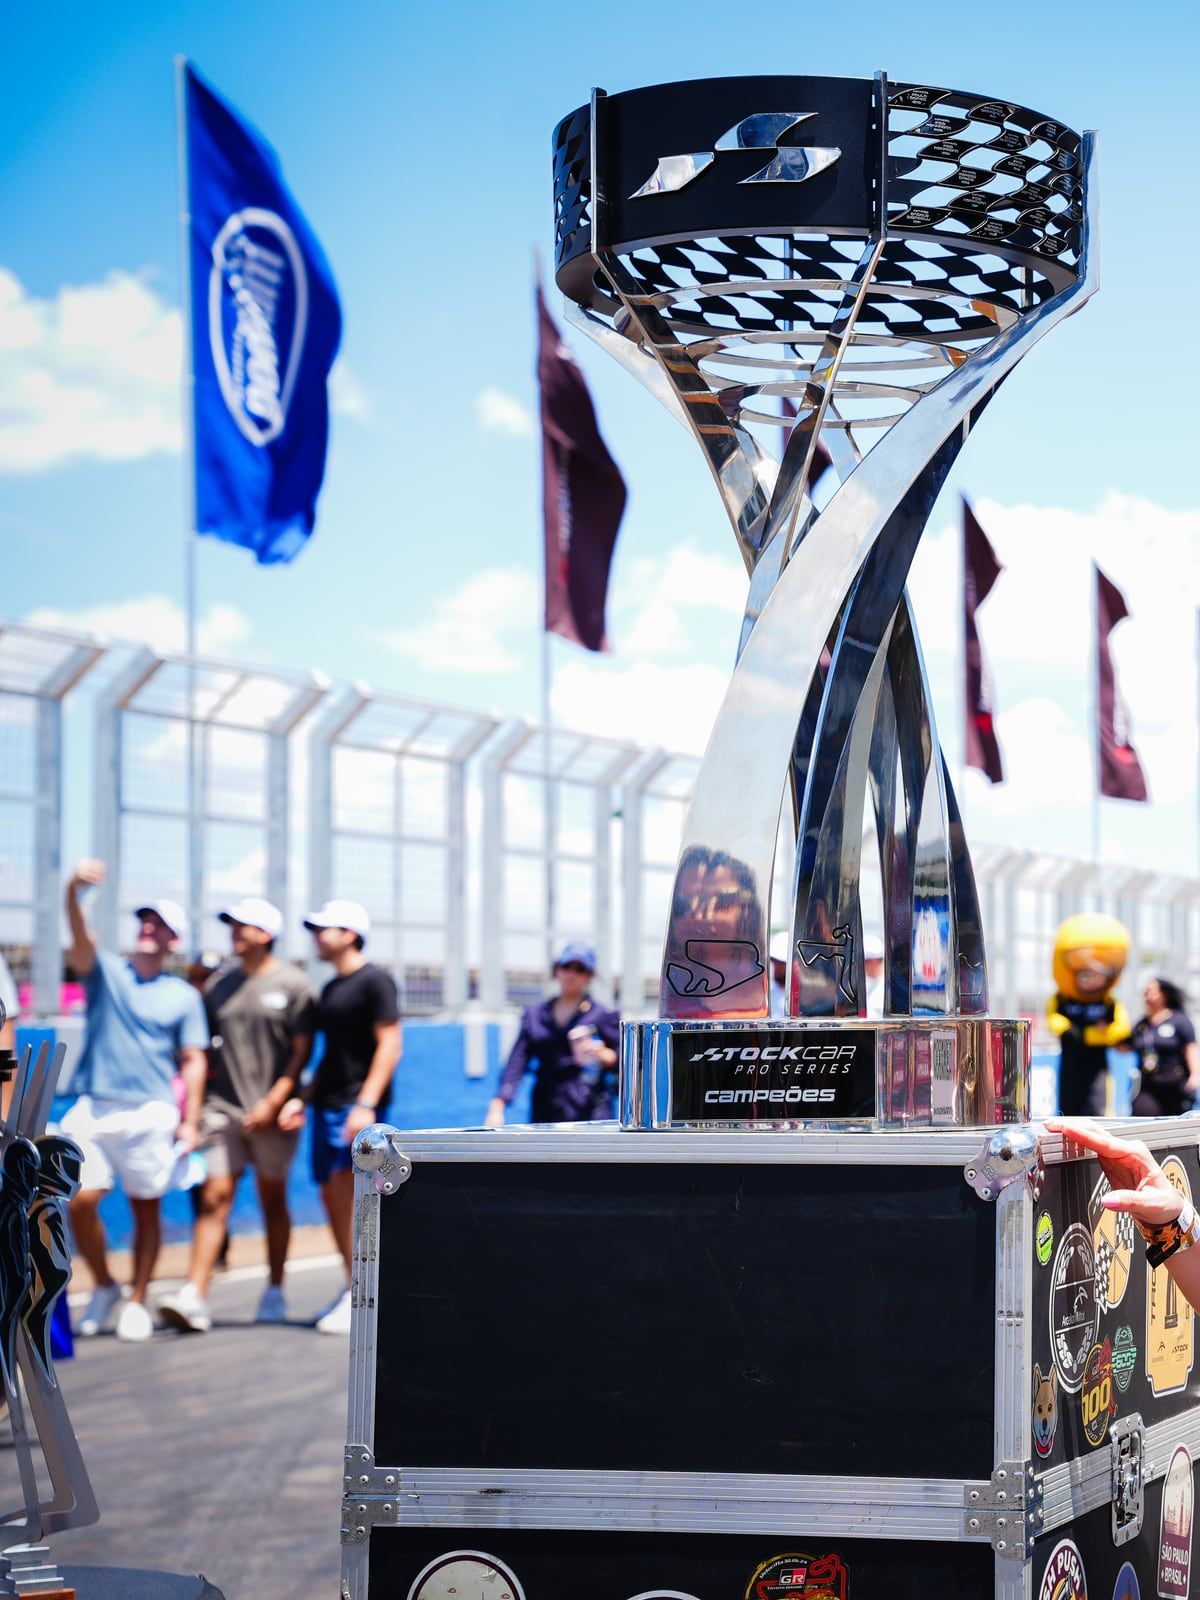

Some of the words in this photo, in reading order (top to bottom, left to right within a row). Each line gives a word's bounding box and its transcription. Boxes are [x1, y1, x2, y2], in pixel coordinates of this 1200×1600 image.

[734, 1064, 770, 1075] PRO
[781, 1063, 852, 1075] SERIES
[704, 1085, 836, 1103] campeões
[1081, 1376, 1111, 1427] 100
[1161, 1541, 1173, 1562] SÃO
[1172, 1547, 1189, 1566] PAULO
[780, 1575, 804, 1584] GR
[1057, 1549, 1082, 1591] PUSH
[1164, 1566, 1183, 1586] BRASIL
